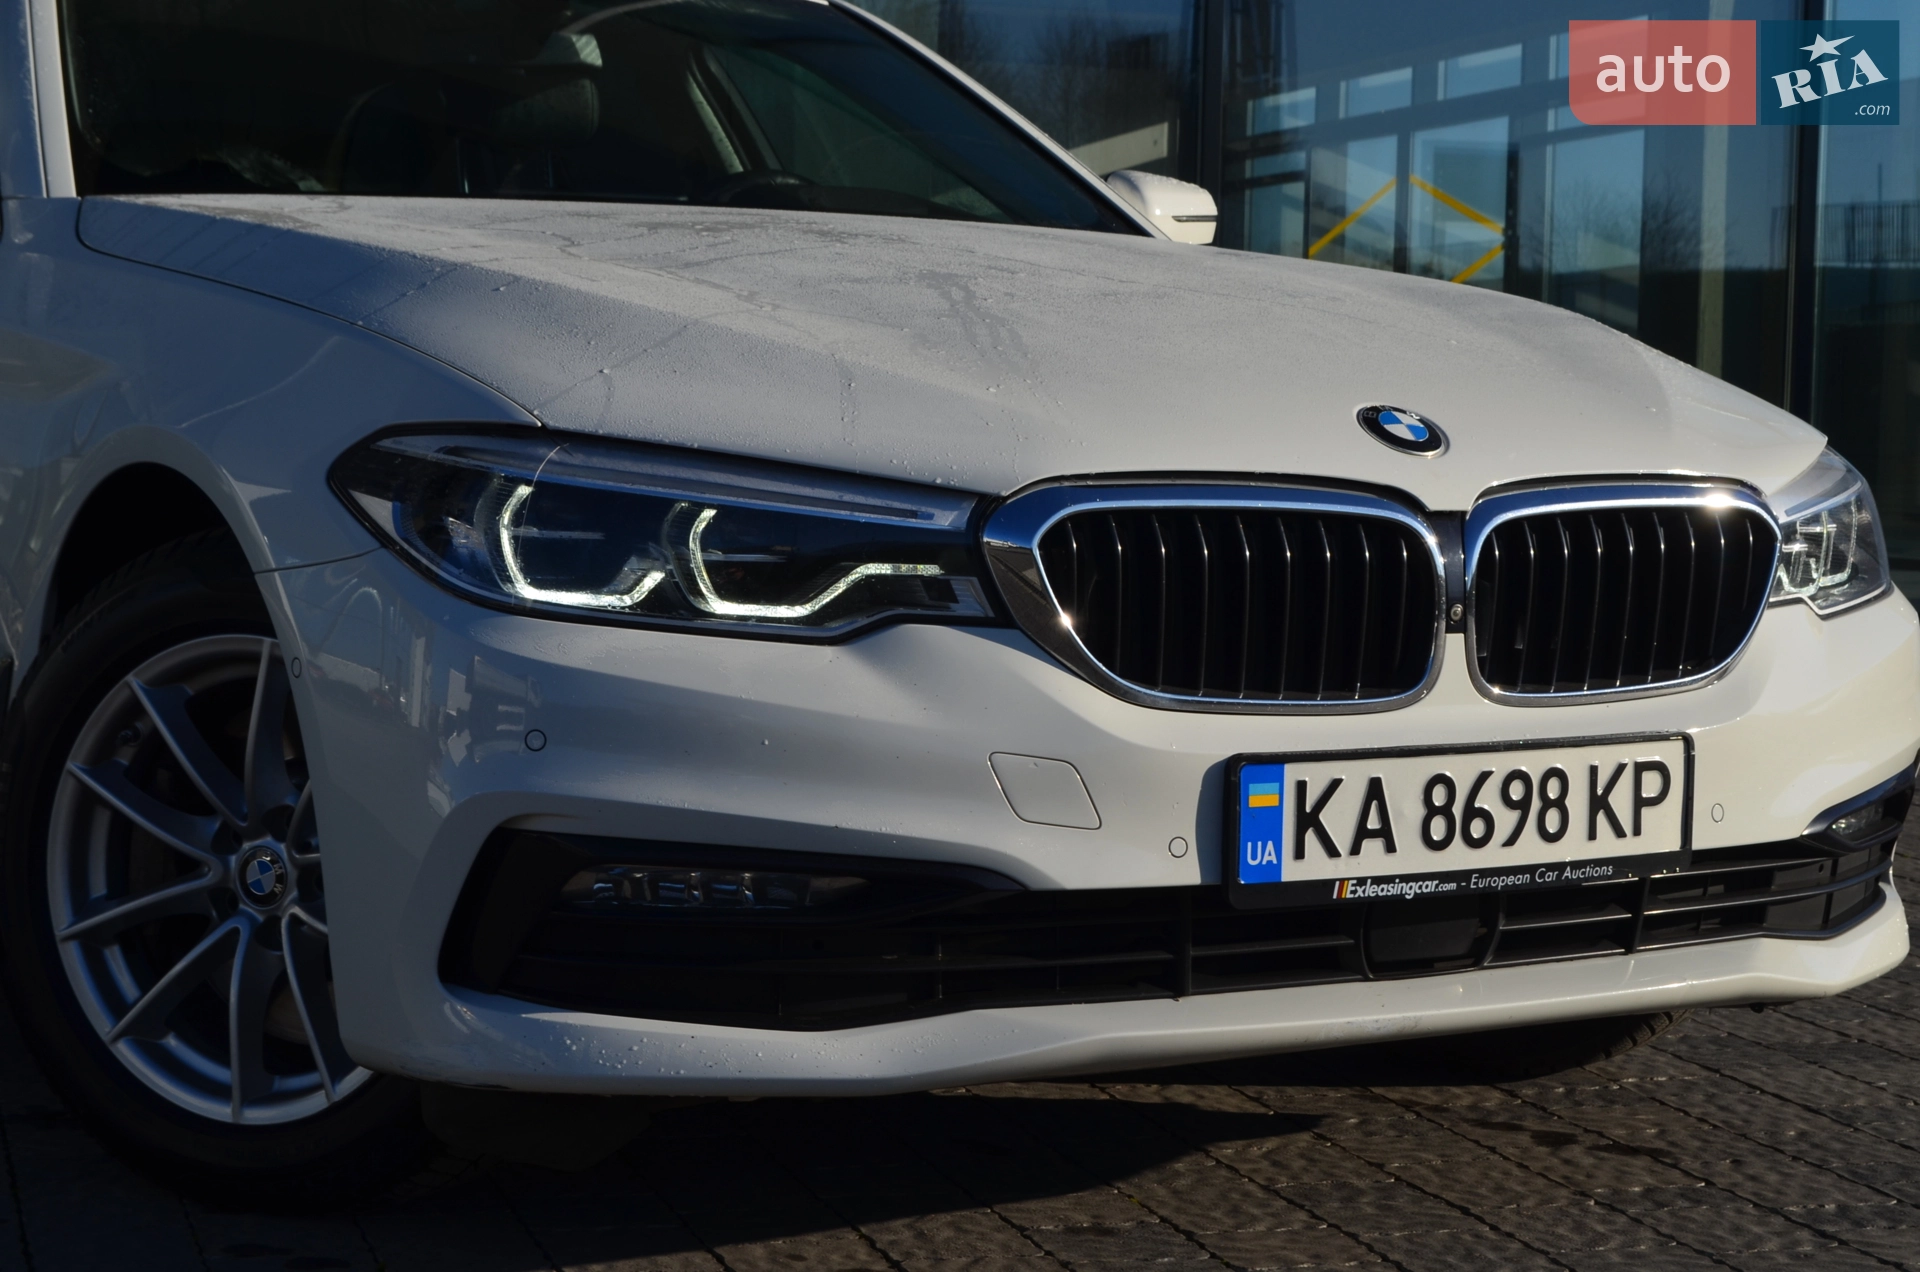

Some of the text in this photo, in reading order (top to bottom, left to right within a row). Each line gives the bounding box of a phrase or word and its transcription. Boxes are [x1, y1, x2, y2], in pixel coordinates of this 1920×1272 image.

[1294, 756, 1672, 860] KA 8698 KP
[1247, 841, 1278, 866] UA
[1470, 872, 1531, 891] European
[1535, 867, 1558, 883] Car
[1562, 864, 1614, 881] Auctions
